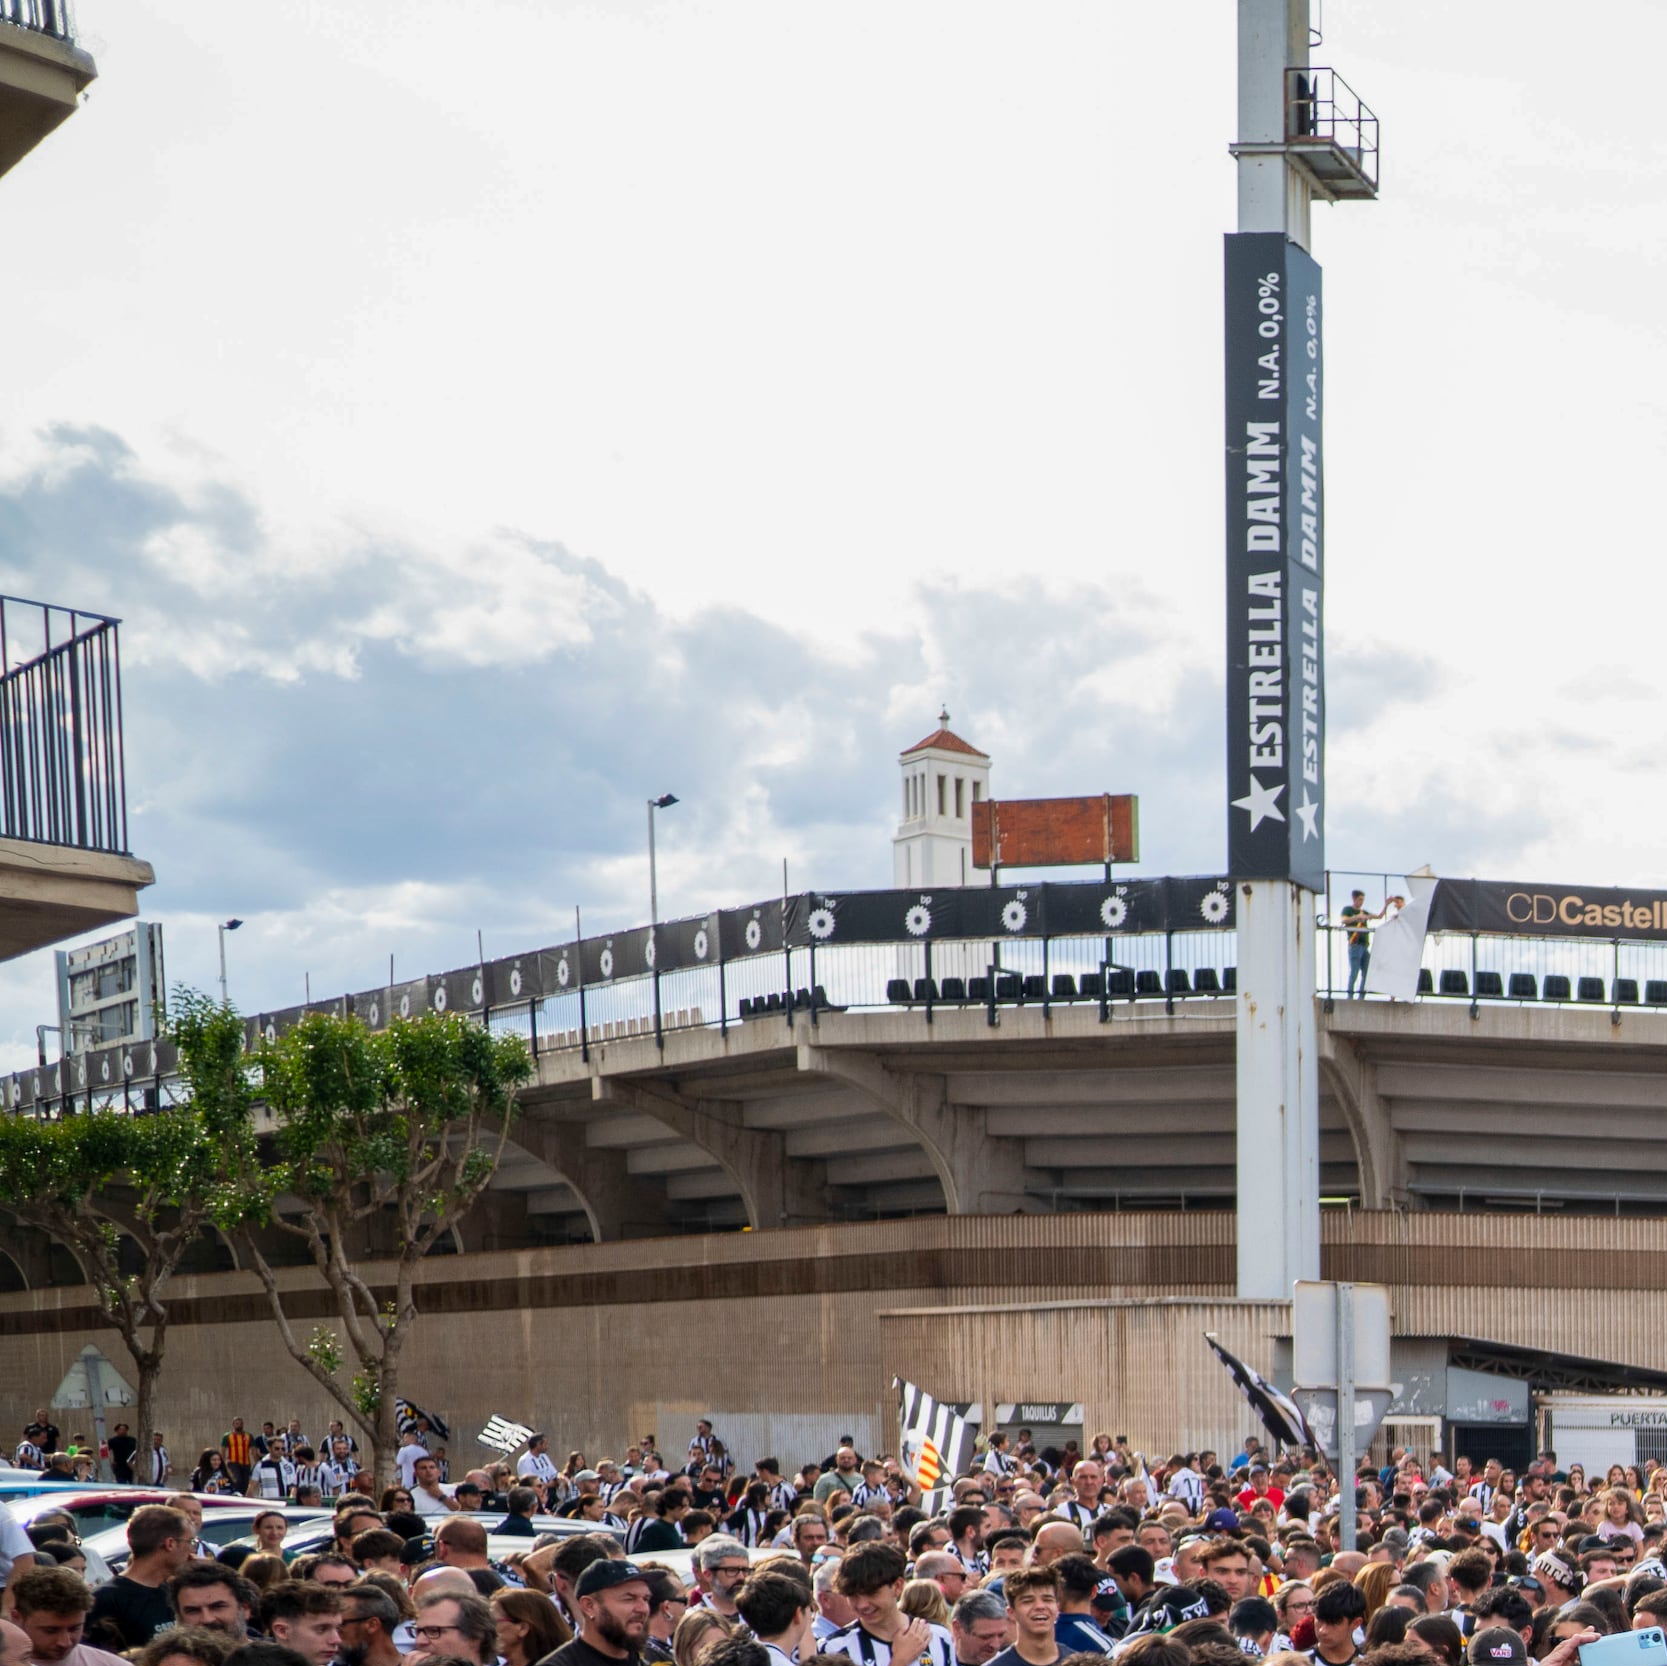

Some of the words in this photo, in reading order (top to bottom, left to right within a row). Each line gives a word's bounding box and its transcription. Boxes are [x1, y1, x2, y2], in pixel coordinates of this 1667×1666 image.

[1257, 272, 1284, 339] 0,0%
[1257, 344, 1280, 399] N.A.
[1305, 366, 1318, 420] N.A.
[1246, 421, 1281, 553] DAMM
[1301, 434, 1318, 571] DAMM
[1248, 569, 1283, 768] ESTRELLA
[1302, 588, 1319, 785] ESTRELLA
[920, 895, 931, 907] bp
[1116, 885, 1127, 897] bp
[1021, 1404, 1057, 1421] TAQUILLAS
